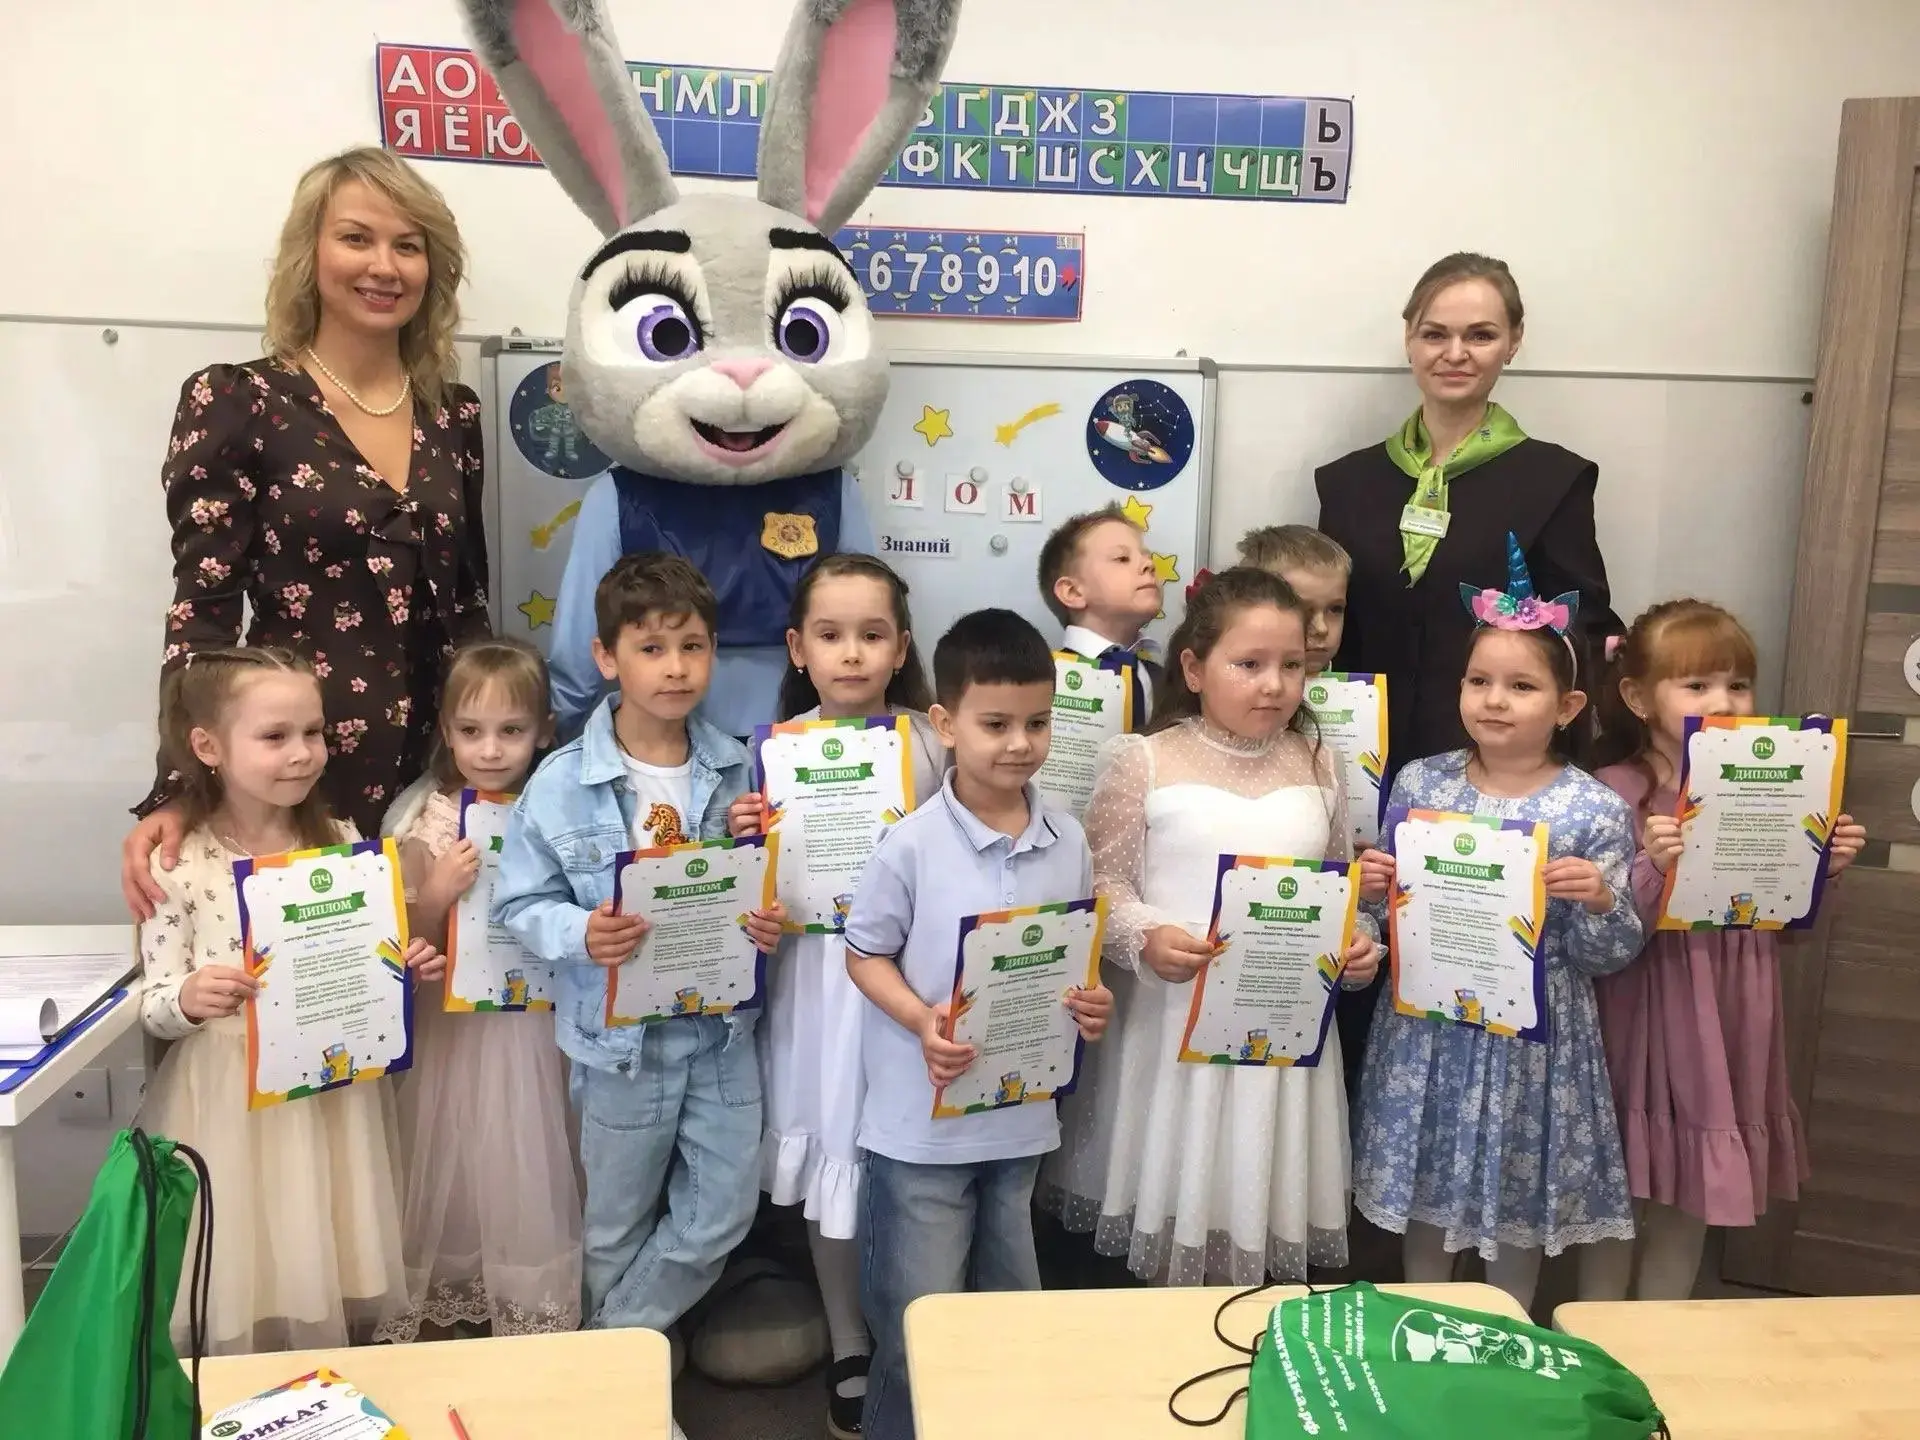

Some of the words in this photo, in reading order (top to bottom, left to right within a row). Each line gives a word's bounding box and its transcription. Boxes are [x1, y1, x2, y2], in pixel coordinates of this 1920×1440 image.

[387, 54, 427, 96] А
[434, 58, 477, 98] О
[632, 71, 664, 112] Н
[675, 74, 717, 115] М
[725, 78, 758, 117] Л
[956, 92, 981, 129] Г
[994, 94, 1030, 137] Д
[1038, 95, 1079, 134] Ж
[1090, 98, 1117, 135] З
[1318, 108, 1342, 143] Ь
[394, 109, 422, 148] Я
[444, 106, 472, 152] Ё
[486, 114, 528, 156] Ю
[902, 140, 939, 177] Ф
[953, 142, 981, 180] К
[1000, 144, 1027, 181] Т
[1038, 145, 1077, 183] Ш
[1088, 148, 1116, 185] С
[1131, 150, 1161, 187] Х
[1177, 151, 1207, 193] Ц
[1223, 153, 1249, 190] Ч
[1260, 154, 1299, 196] Щ
[1310, 157, 1336, 192] Ъ
[869, 250, 892, 291] 6
[905, 252, 928, 292] 7
[940, 254, 963, 294] 8
[977, 255, 1000, 295] 9
[1012, 256, 1057, 297] 10
[881, 535, 951, 554] Знаний
[808, 768, 860, 782] ДИПЛОМ
[1733, 768, 1789, 781] ДИПЛОМ
[1436, 861, 1489, 878] ДИПЛОМ
[668, 883, 722, 897] ДИПЛОМ
[297, 898, 353, 922] ДИПЛОМ
[1259, 907, 1308, 920] ДИПЛОМ
[1004, 952, 1053, 969] ДИПЛОМ
